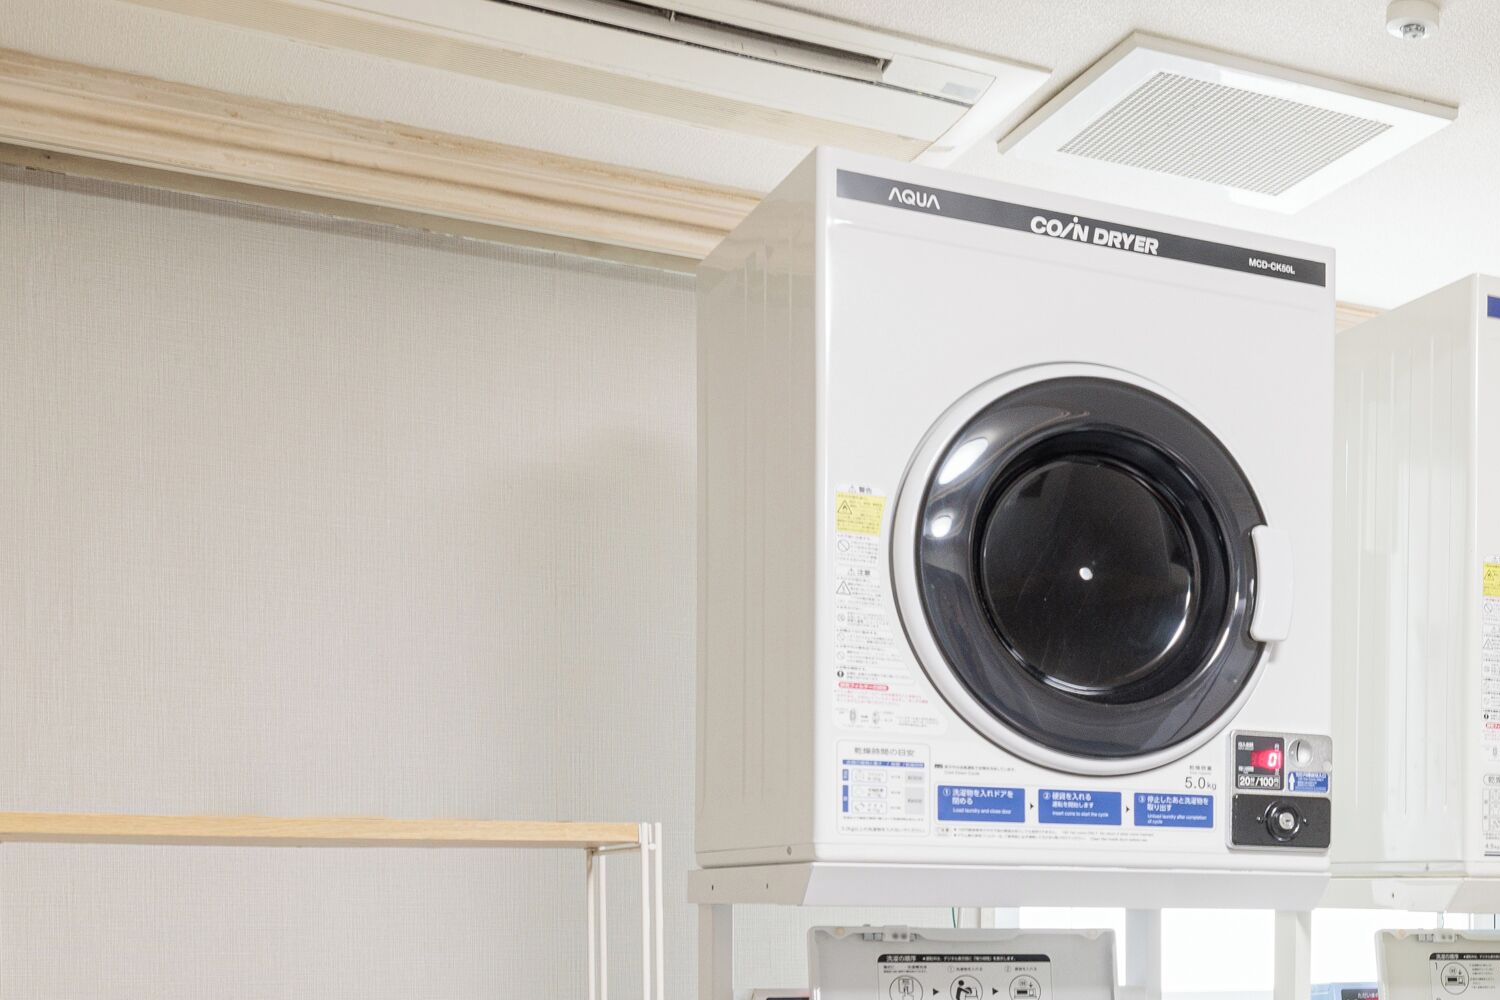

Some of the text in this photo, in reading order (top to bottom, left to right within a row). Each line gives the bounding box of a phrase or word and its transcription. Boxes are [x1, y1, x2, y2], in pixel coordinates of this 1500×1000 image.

[888, 186, 940, 210] AQUA
[1094, 228, 1159, 255] DRYER
[1267, 752, 1277, 767] 0
